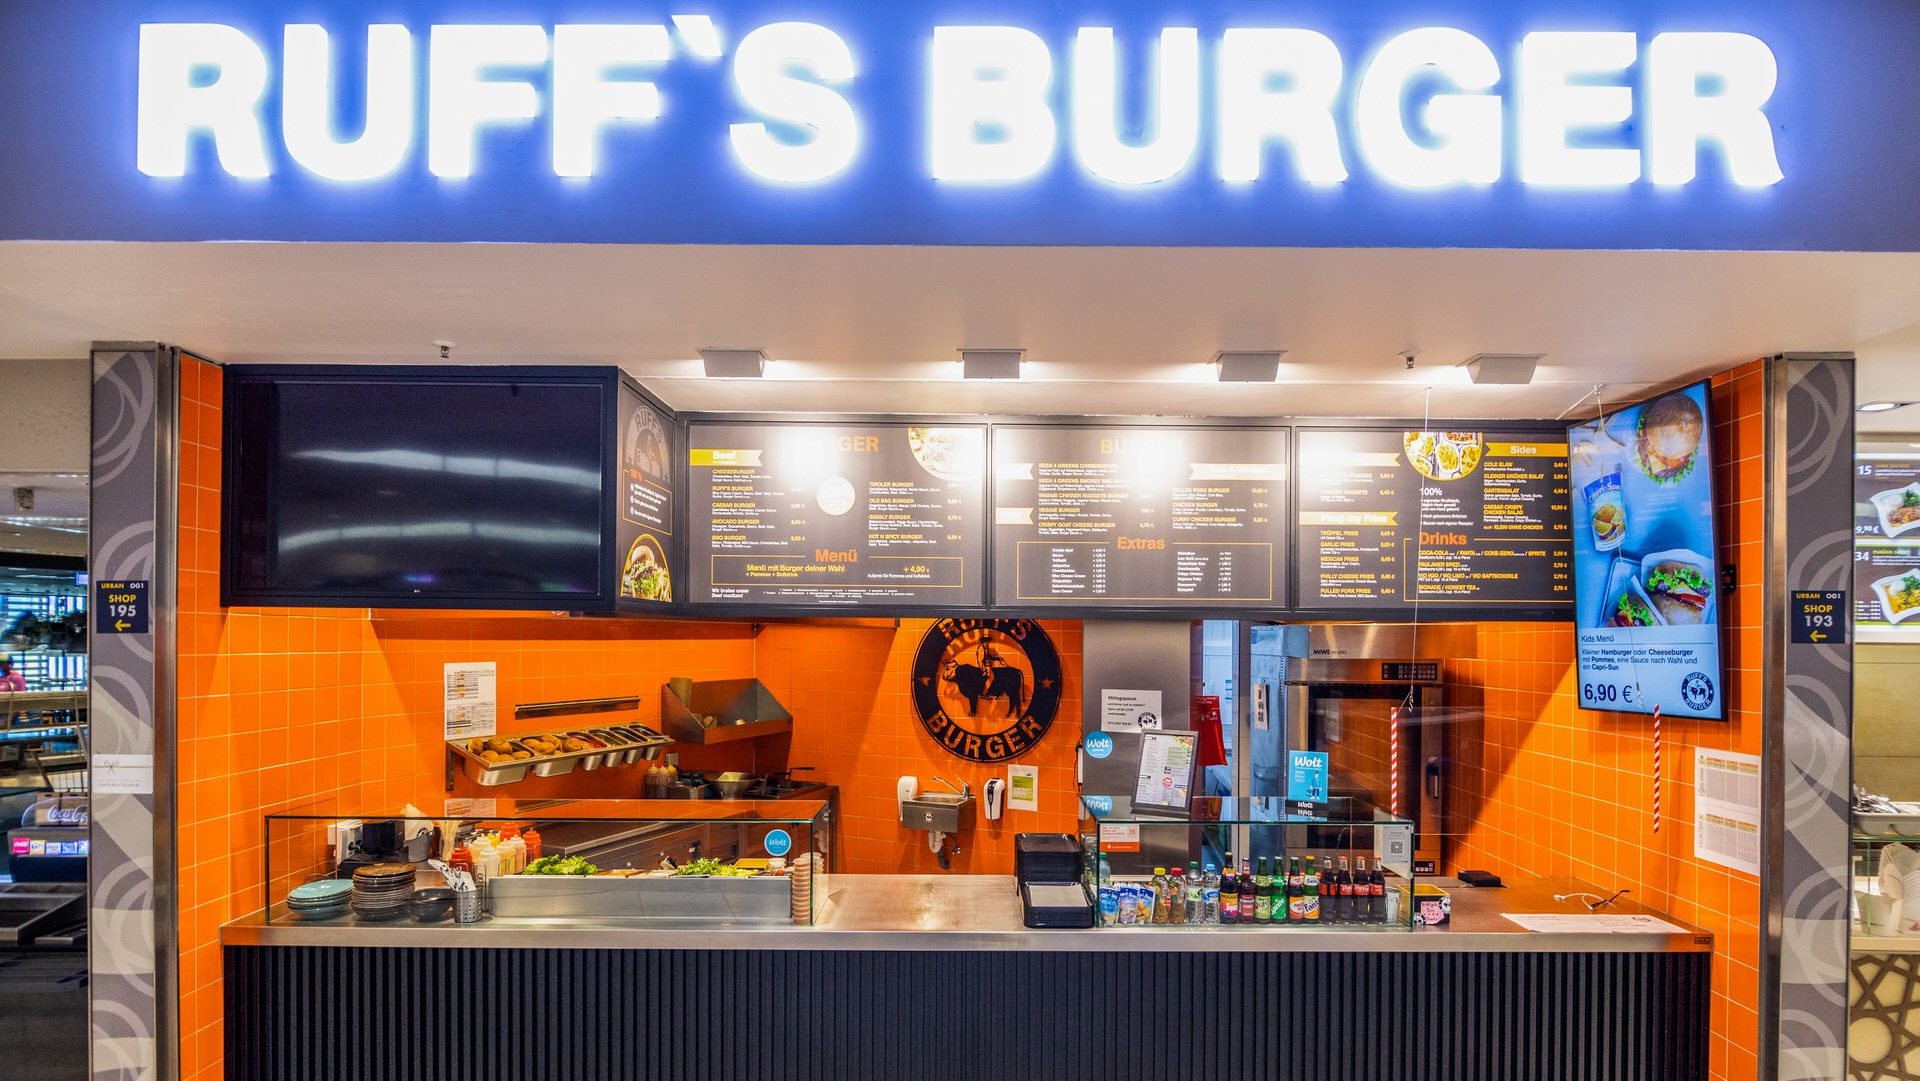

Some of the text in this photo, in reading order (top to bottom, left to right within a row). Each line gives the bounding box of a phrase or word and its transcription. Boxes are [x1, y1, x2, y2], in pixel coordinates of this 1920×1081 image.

[933, 27, 1786, 186] BURGER
[713, 450, 736, 460] Beef
[1510, 446, 1537, 454] Sides
[1857, 465, 1872, 475] 15
[1419, 487, 1443, 496] 100%
[1589, 483, 1621, 504] Capri-Sun
[1856, 525, 1880, 534] 9,90 €
[1117, 536, 1166, 550] Extras
[1419, 532, 1467, 545] Drinks
[815, 549, 857, 563] Menü
[1854, 551, 1870, 561] 34
[780, 565, 803, 573] Burger
[108, 594, 137, 603] SHOP
[109, 605, 137, 617] 195
[1803, 604, 1834, 613] SHOP
[1805, 615, 1833, 627] 193
[1581, 634, 1615, 643] Kids Menü
[1601, 649, 1632, 657] Hamburger
[1648, 648, 1694, 657] Cheeseburger
[1630, 656, 1649, 664] Sauce
[1684, 656, 1698, 664] und
[1591, 663, 1620, 671] Capri-Sun
[1584, 683, 1633, 704] 6,90 €
[926, 710, 1044, 759] BURGER
[1087, 738, 1110, 749] Wolt
[1294, 756, 1323, 768] Wolt
[768, 838, 787, 846] Wolt
